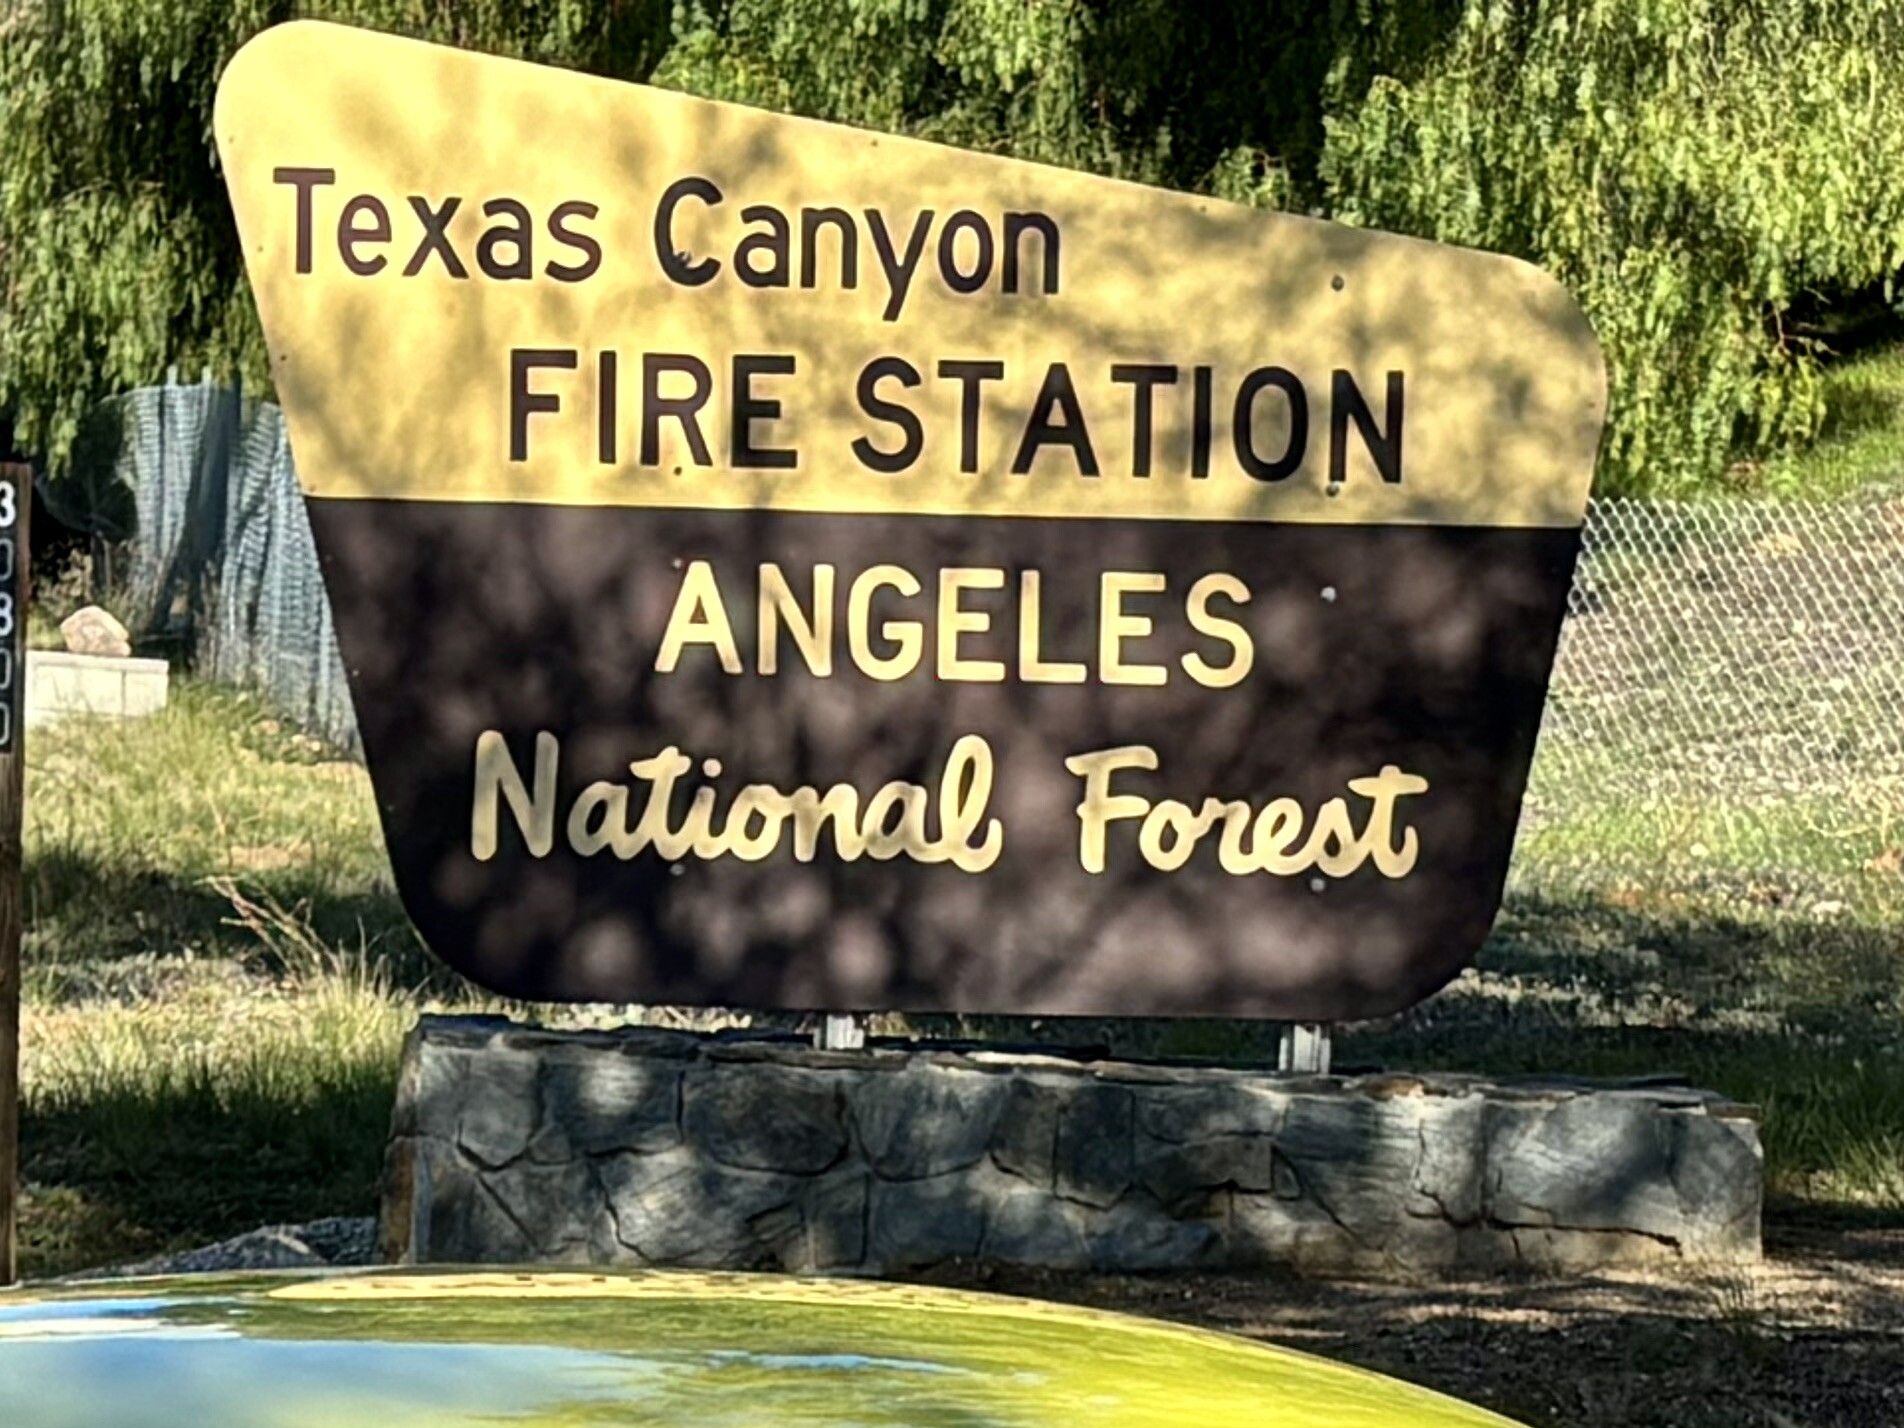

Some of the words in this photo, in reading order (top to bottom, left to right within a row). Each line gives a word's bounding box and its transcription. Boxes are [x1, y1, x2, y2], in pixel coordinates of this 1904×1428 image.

[275, 168, 601, 282] Texas
[655, 178, 1059, 321] Canyon
[511, 349, 797, 468] FIRE
[852, 357, 1405, 484] STATION
[655, 561, 1254, 687] ANGELES
[471, 731, 1003, 873] National
[1064, 746, 1429, 878] Forest
